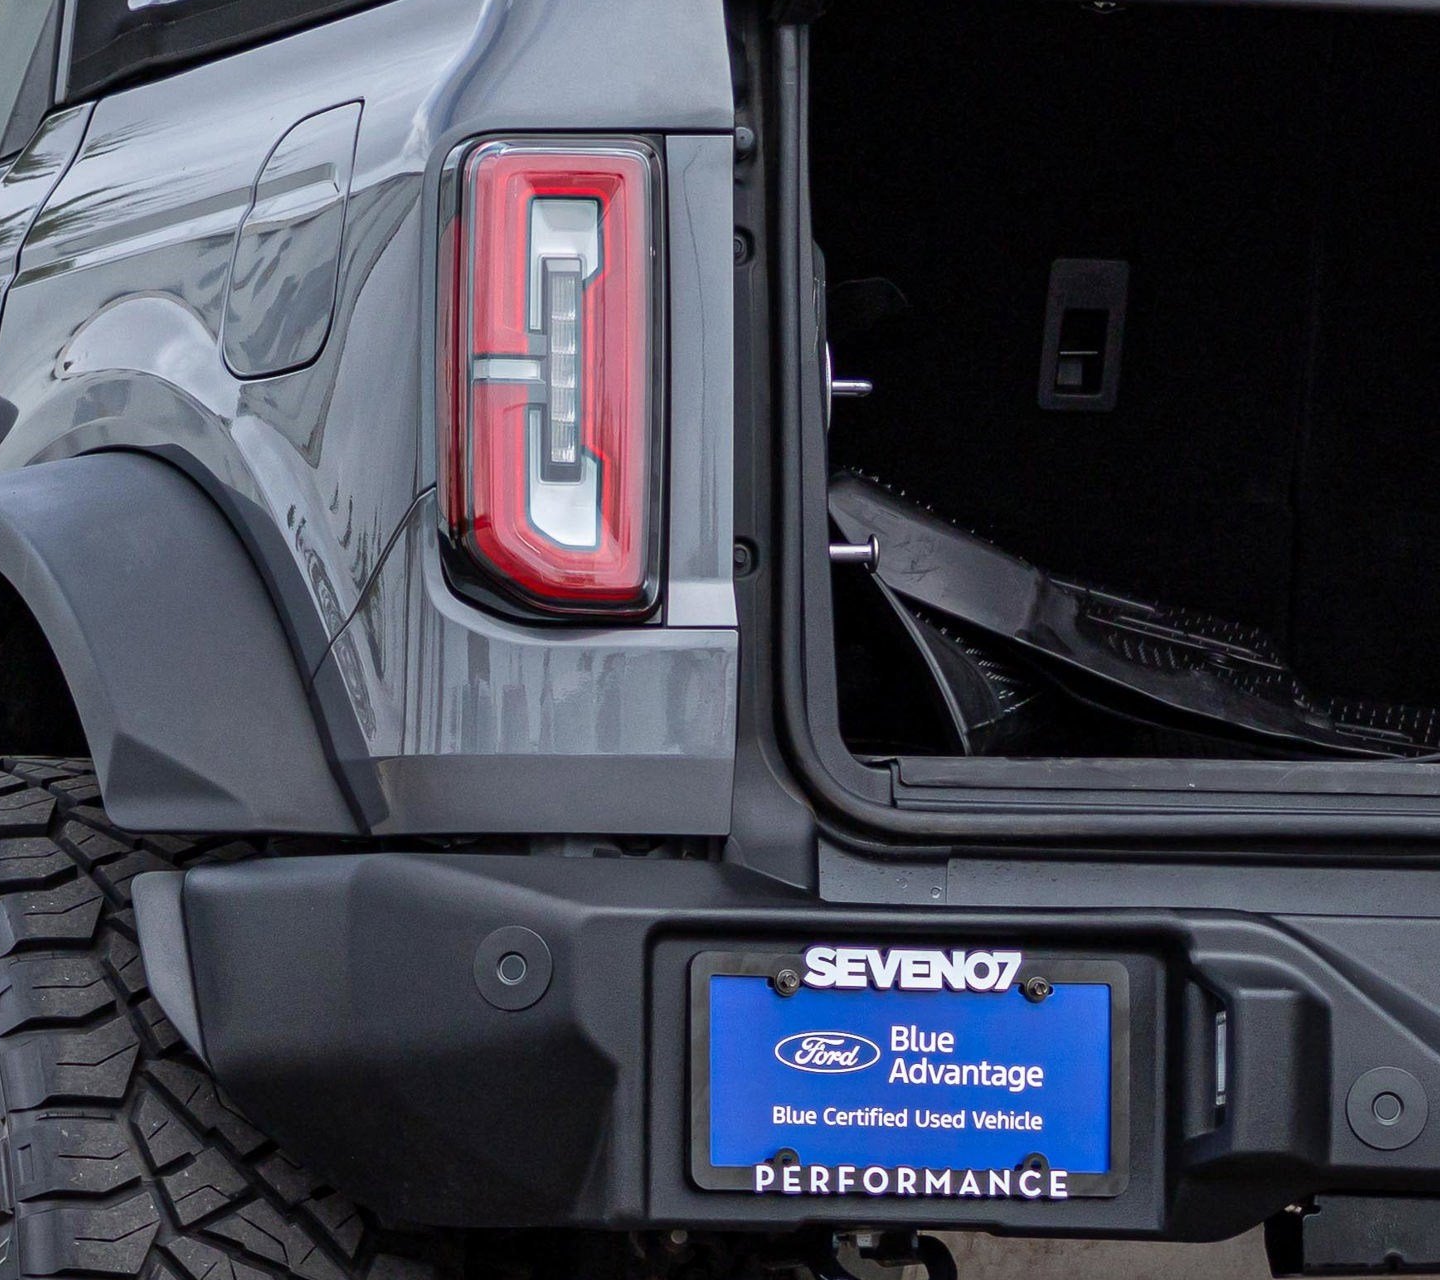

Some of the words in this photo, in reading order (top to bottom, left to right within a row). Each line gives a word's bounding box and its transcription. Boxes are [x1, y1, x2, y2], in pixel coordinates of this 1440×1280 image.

[794, 1036, 860, 1067] Ford
[891, 1026, 954, 1054] Blue
[889, 1056, 1044, 1092] Advantage
[772, 1105, 817, 1127] Blue
[823, 1106, 908, 1129] Certified
[915, 1109, 965, 1130] Used
[972, 1111, 1043, 1132] Vehicle
[755, 1165, 1069, 1198] PERFORMANCE
